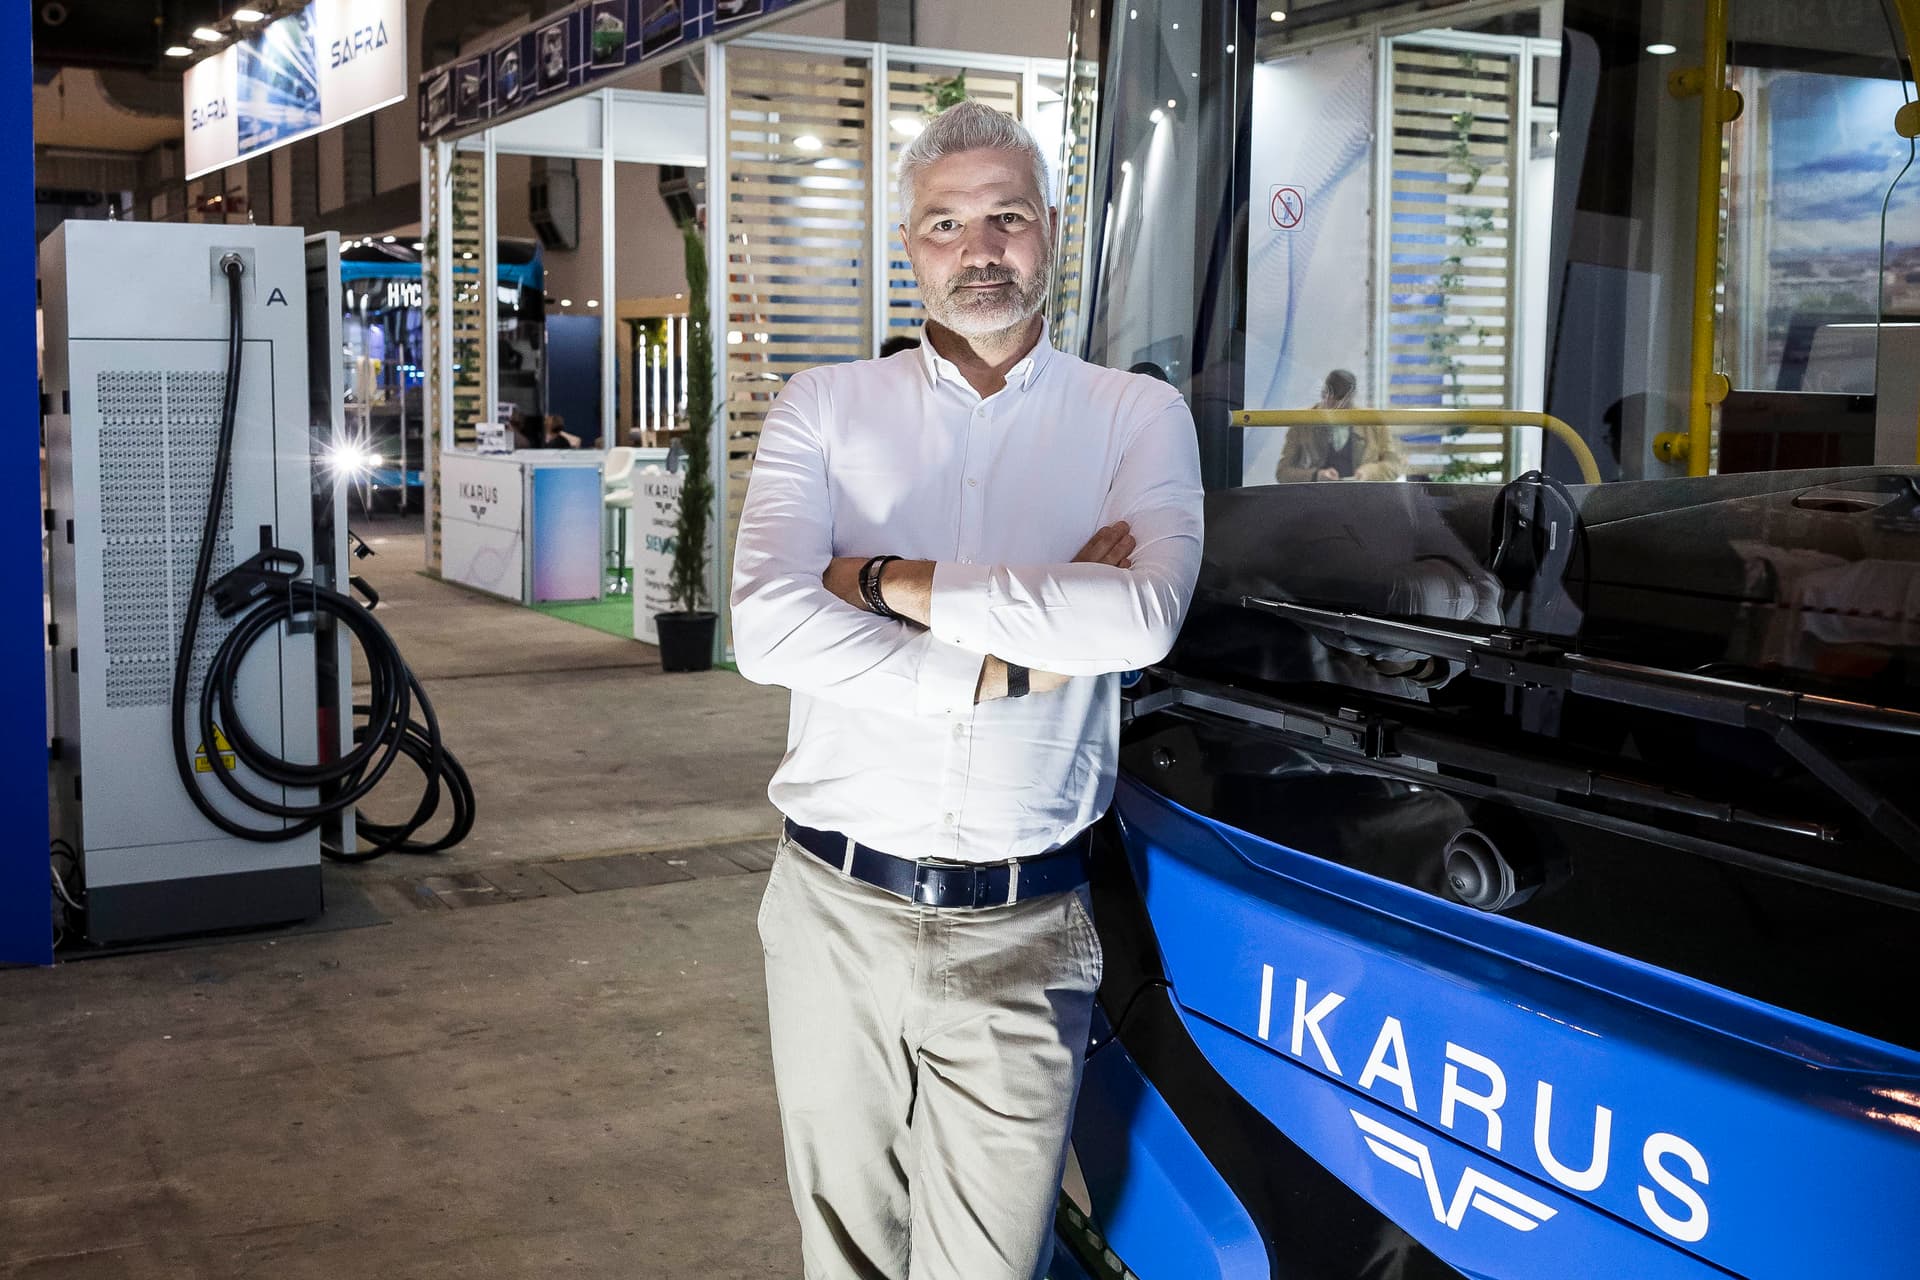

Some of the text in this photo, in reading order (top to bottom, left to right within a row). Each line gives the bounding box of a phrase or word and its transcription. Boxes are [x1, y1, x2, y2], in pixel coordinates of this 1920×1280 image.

[331, 18, 388, 69] SAFRA
[266, 287, 288, 307] A
[459, 482, 498, 504] IKARUS
[1258, 963, 1709, 1243] IKARUS
